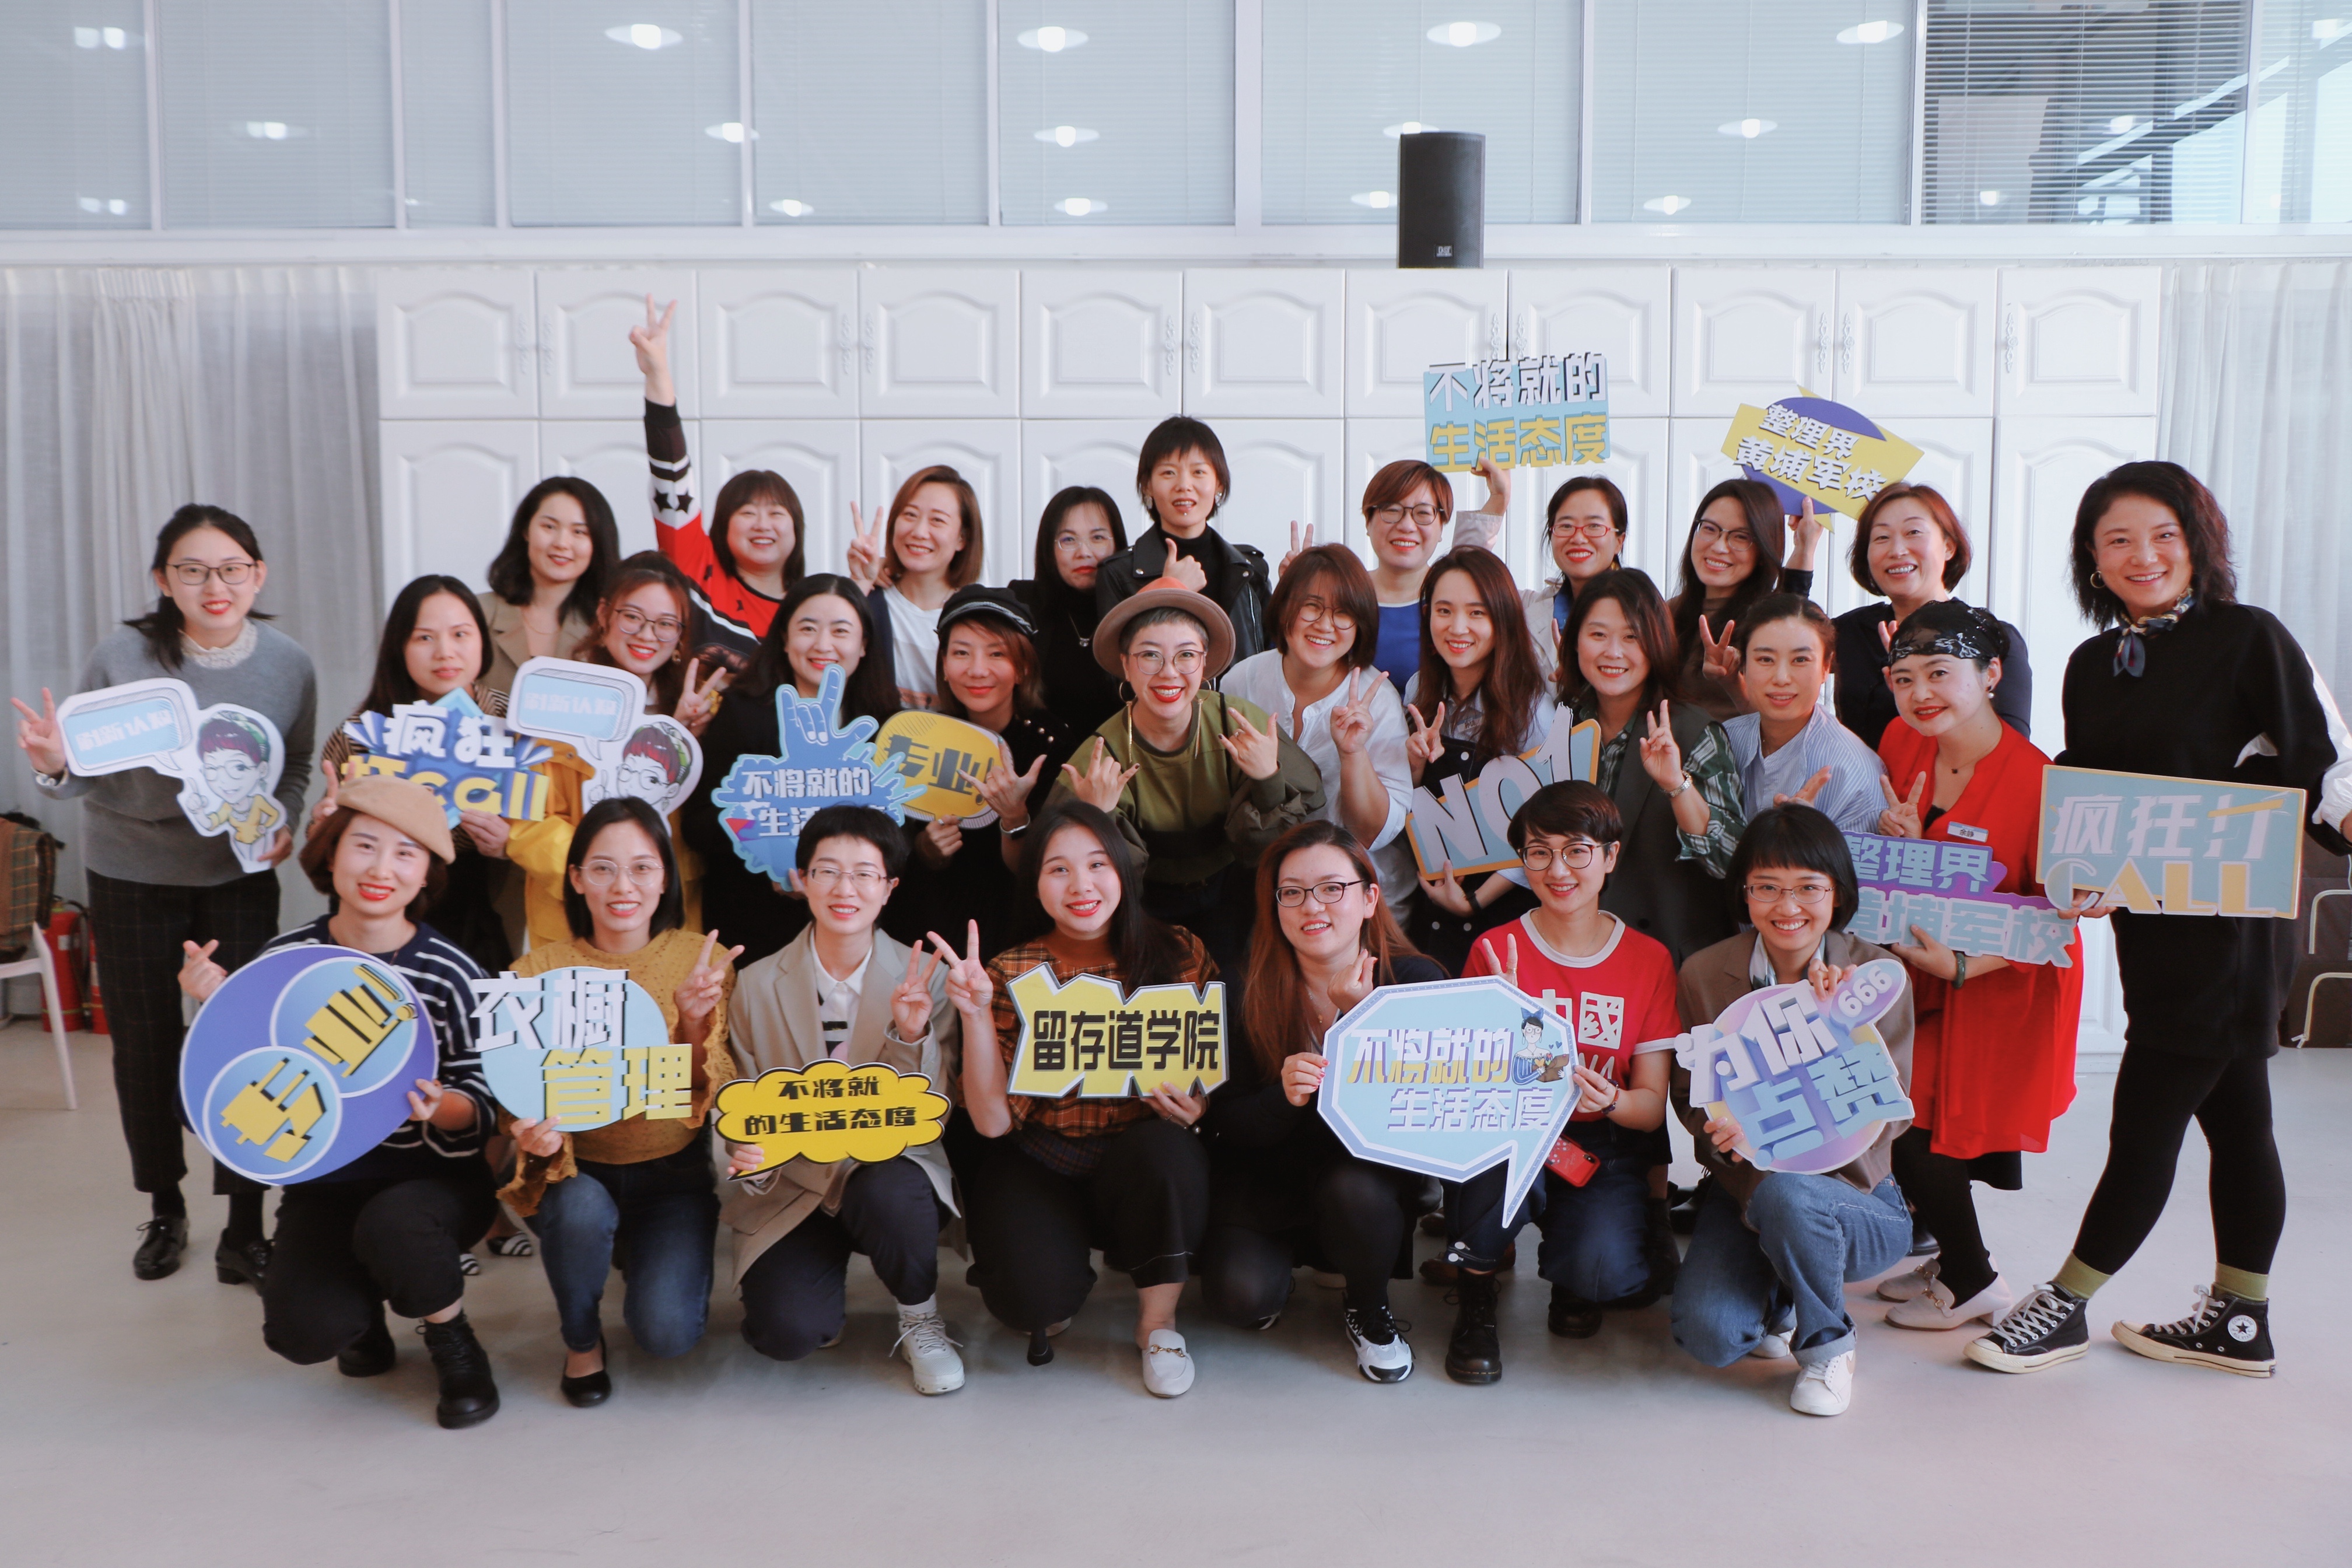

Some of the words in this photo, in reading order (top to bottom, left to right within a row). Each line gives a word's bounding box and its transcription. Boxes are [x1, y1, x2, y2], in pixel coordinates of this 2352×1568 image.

[1429, 352, 1606, 411] 不将就的
[1430, 411, 1606, 473] 生活态度
[1758, 404, 1860, 460] 整理界
[1732, 435, 1888, 501] 黄埔军校
[383, 699, 516, 768] 疯狂
[741, 767, 871, 799] 不将就的
[2050, 794, 2286, 860] 疯狂打
[1845, 835, 1989, 892] 整理界
[2044, 858, 2277, 918] CALL
[470, 970, 629, 1052] 衣橱
[1838, 965, 1893, 1018] 666
[1034, 1010, 1220, 1072] 留存道学院
[1347, 1027, 1514, 1084] 不将就的
[1674, 979, 1839, 1107] 为你
[541, 1044, 692, 1125] 管理
[778, 1076, 881, 1100] 不将就
[1388, 1087, 1554, 1132] 生活态度
[1741, 1041, 1913, 1167] 点赞
[743, 1107, 917, 1136] 的生活态度
